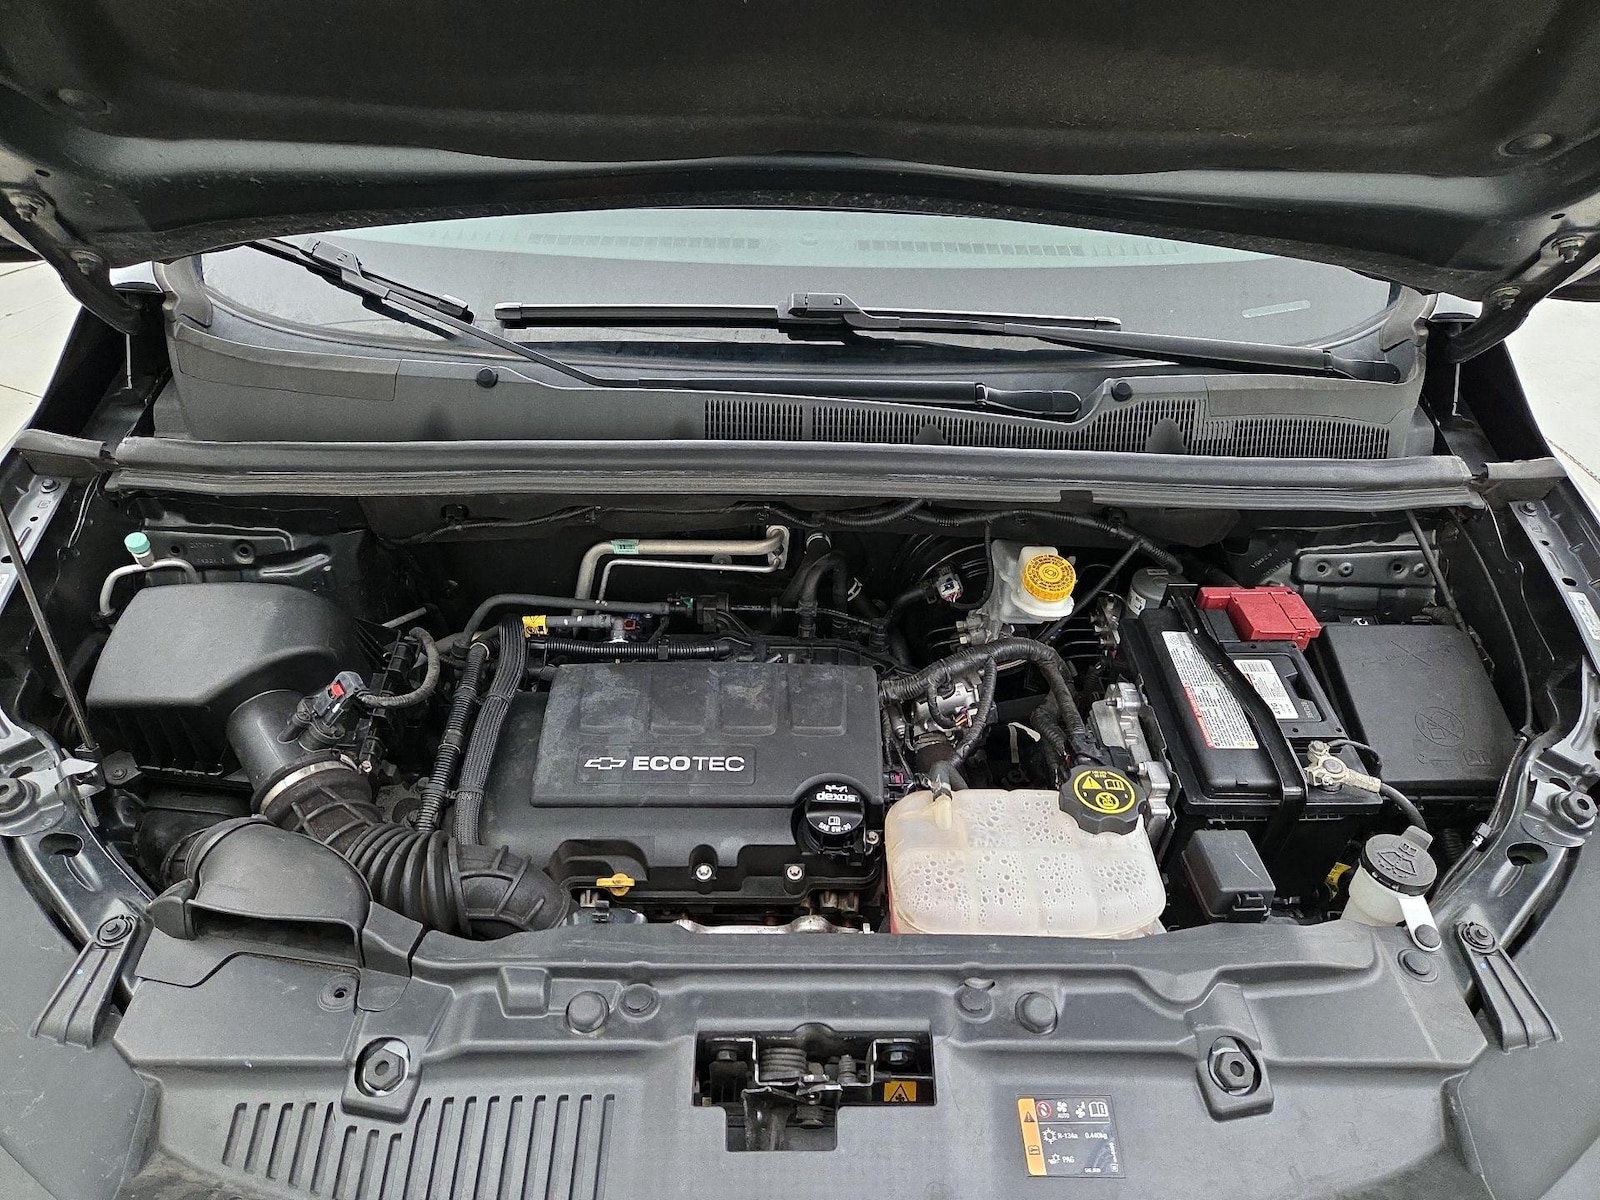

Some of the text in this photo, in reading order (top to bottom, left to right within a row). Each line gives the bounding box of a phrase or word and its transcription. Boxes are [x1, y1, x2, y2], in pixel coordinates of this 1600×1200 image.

[632, 756, 745, 772] ECOTEC
[816, 791, 857, 802] dexos
[1062, 1155, 1075, 1163] PAG
